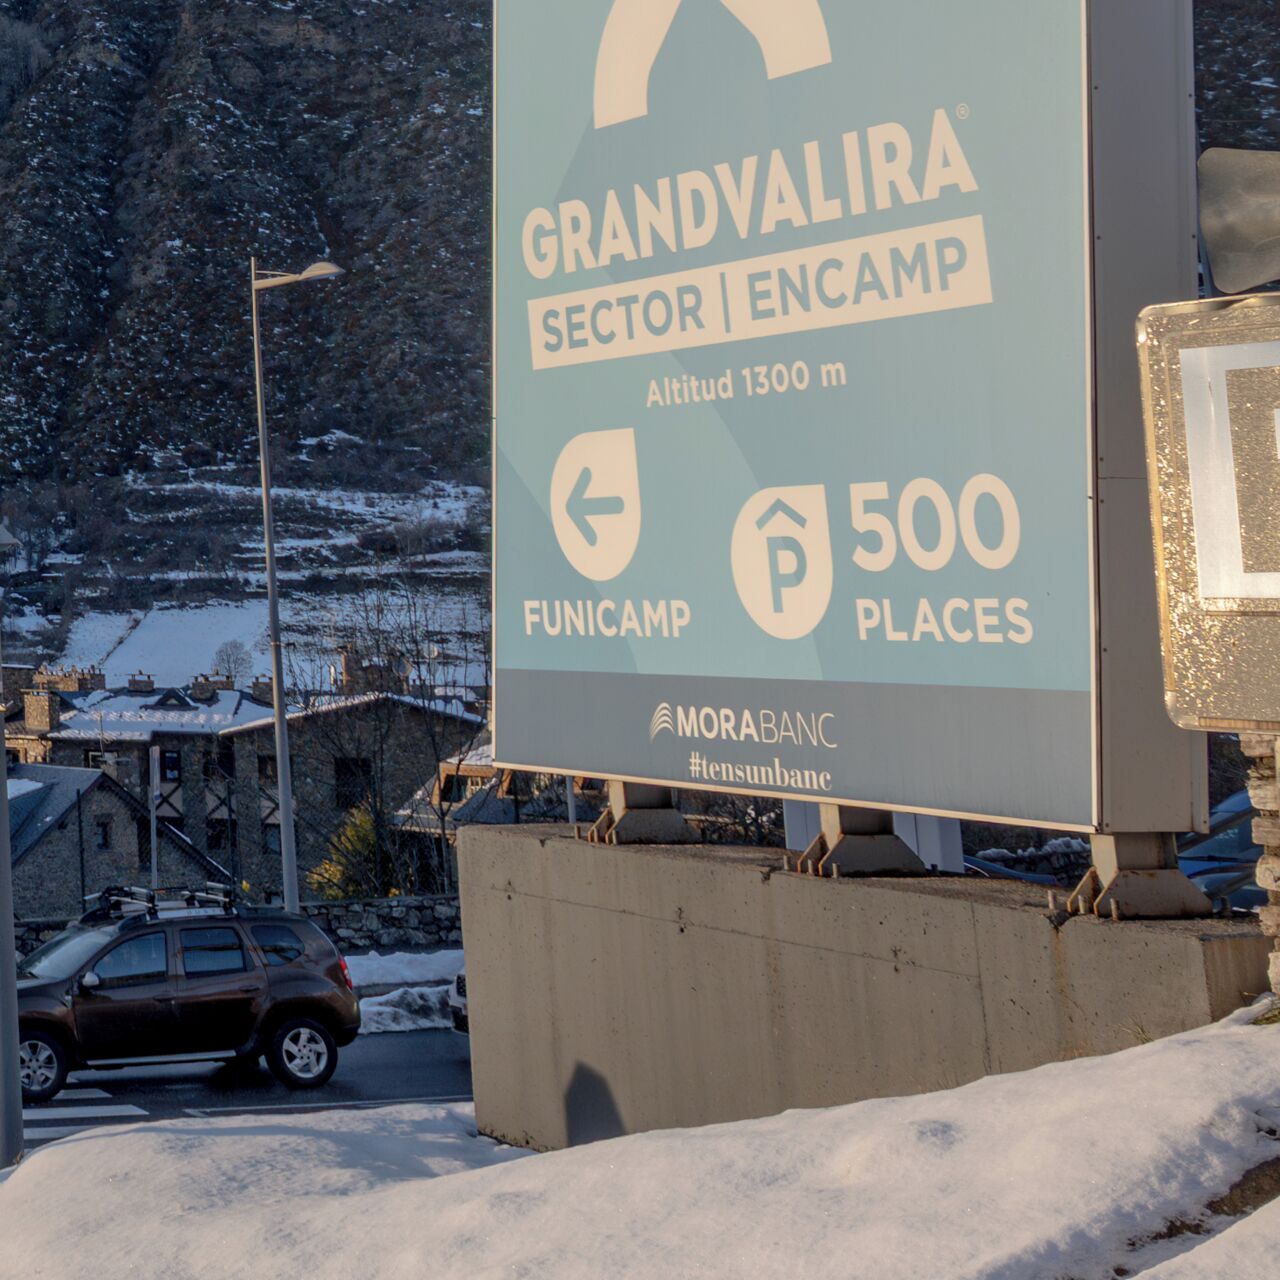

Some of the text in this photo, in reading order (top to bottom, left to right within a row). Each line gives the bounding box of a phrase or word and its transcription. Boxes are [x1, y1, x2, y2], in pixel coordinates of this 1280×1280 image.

[542, 236, 968, 353] SECTOR ENCAMP
[646, 360, 847, 408] Altitud 1300 m
[850, 473, 1020, 572] 500
[524, 600, 691, 638] FUNICAMP
[856, 598, 1034, 644] PLACES
[676, 705, 838, 749] MORABANC
[689, 751, 832, 791] #tensunbanc
